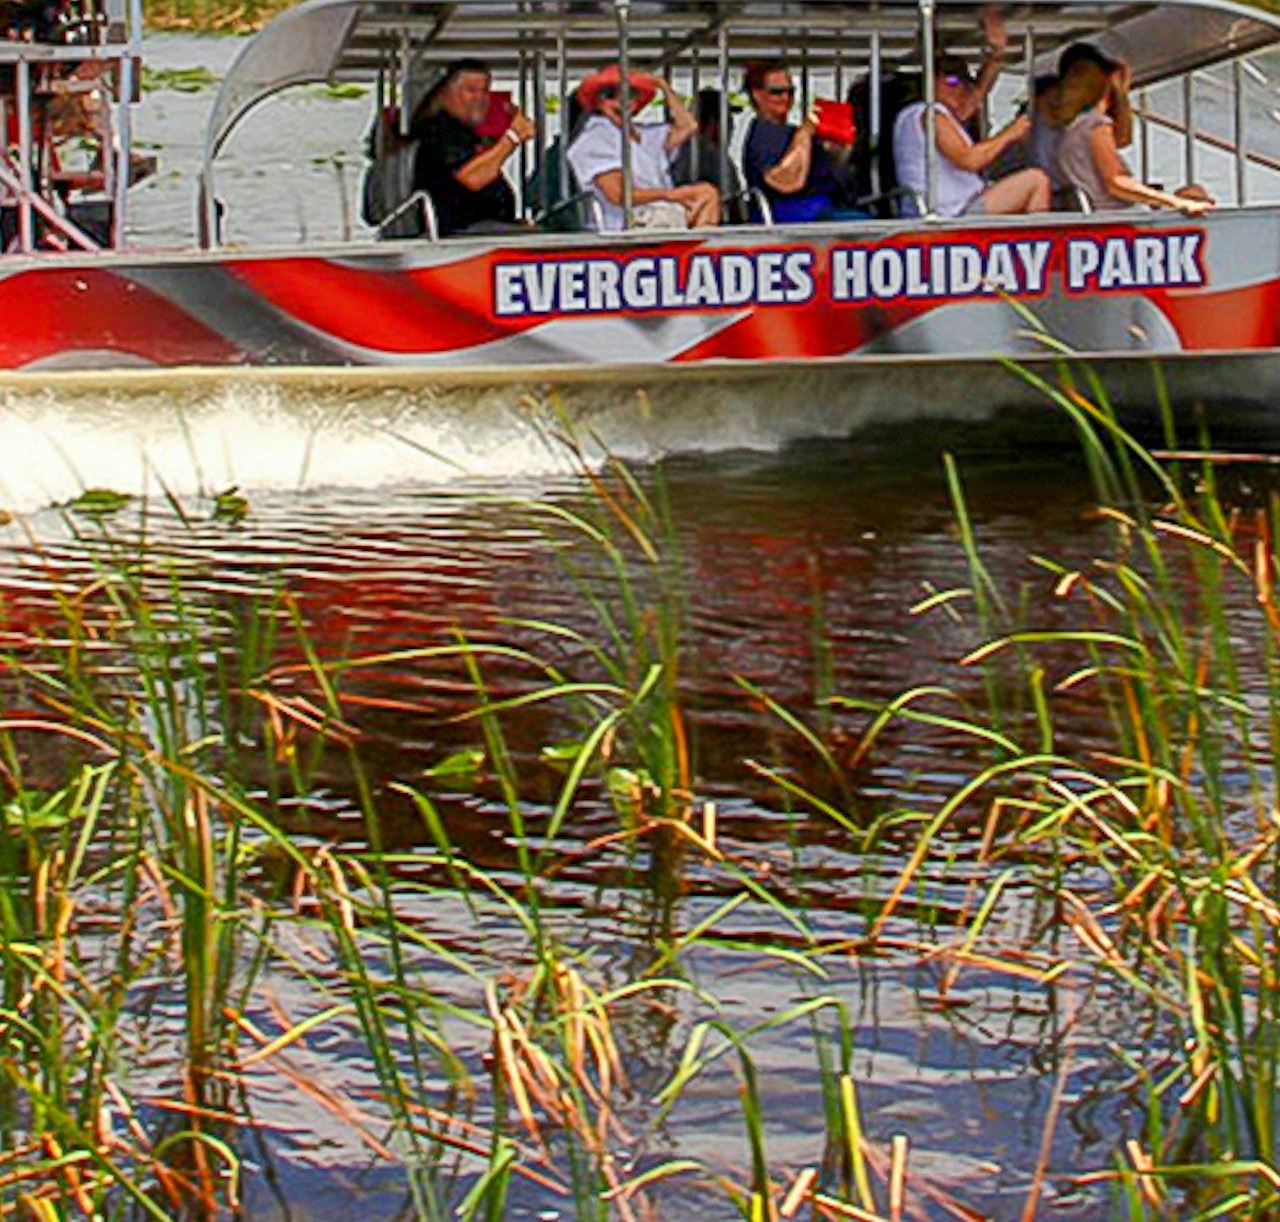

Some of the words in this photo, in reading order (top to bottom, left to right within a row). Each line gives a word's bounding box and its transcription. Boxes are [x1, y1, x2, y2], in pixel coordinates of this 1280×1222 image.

[493, 249, 815, 316] EVERGLADES
[831, 239, 1052, 301] HOLIDAY
[1067, 233, 1204, 290] PARK
